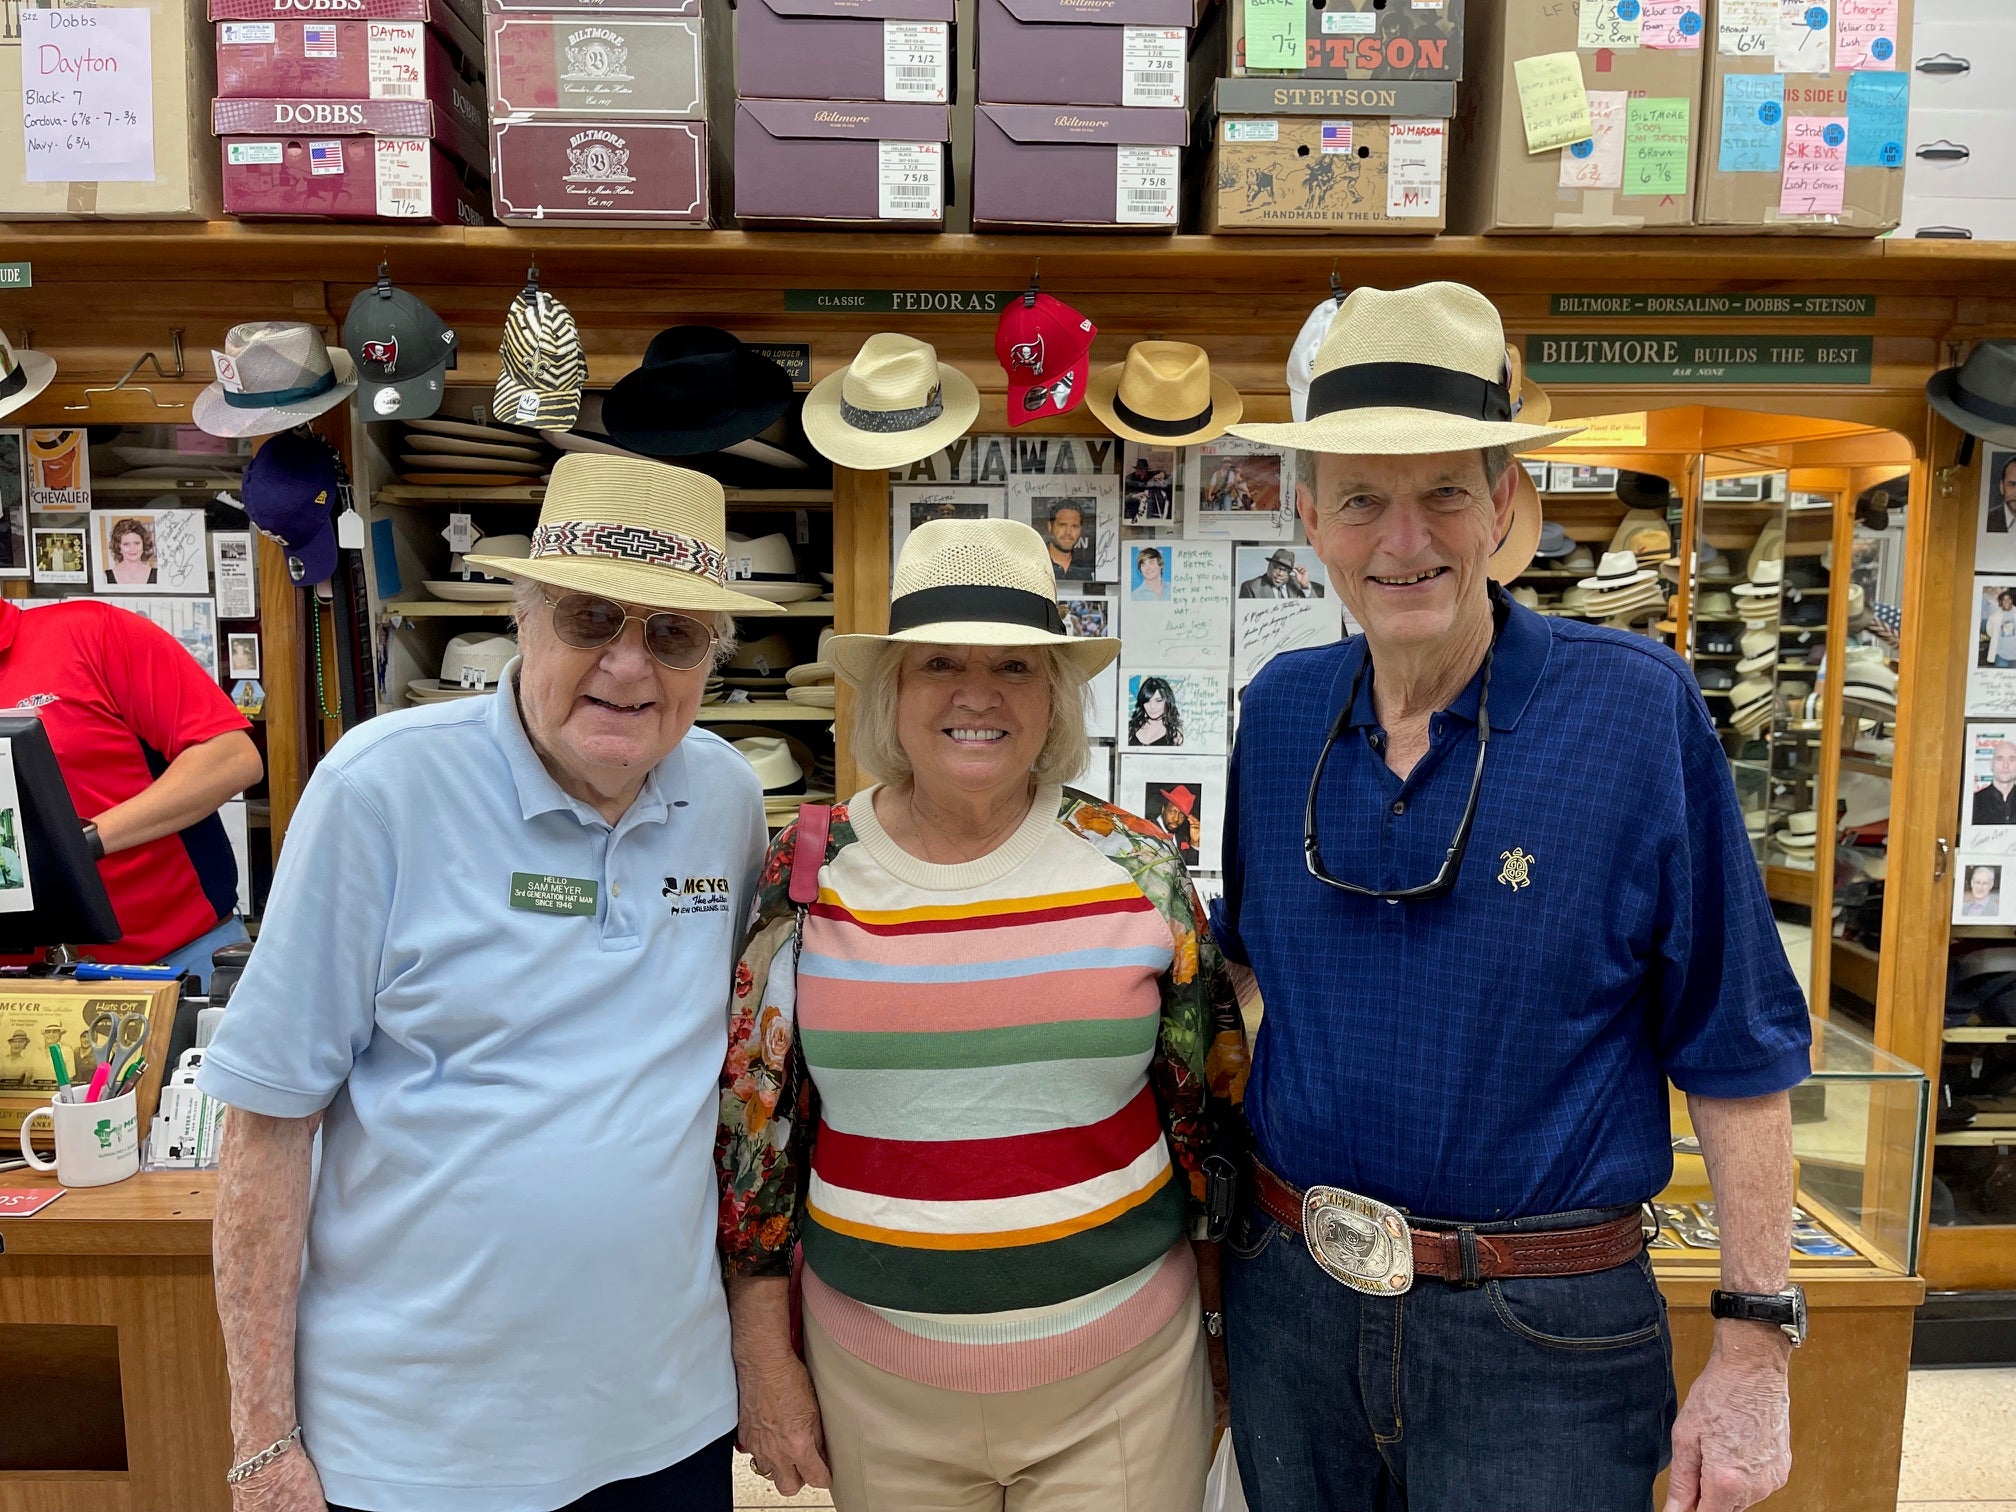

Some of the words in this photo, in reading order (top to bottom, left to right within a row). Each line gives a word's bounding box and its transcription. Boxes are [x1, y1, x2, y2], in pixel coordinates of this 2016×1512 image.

[1842, 1, 1888, 20] Charger
[49, 11, 97, 29] Dobbs
[369, 25, 415, 40] DAYTON
[568, 27, 625, 46] BILTMORE
[1840, 37, 1860, 48] Lush
[393, 46, 417, 57] NAVY
[38, 43, 118, 82] Dayton
[909, 55, 915, 63] 7
[917, 55, 935, 64] 1/2
[1156, 61, 1173, 69] 3/8
[73, 90, 83, 105] 7
[1274, 89, 1397, 107] STETSON
[1804, 89, 1834, 103] SIDE
[274, 104, 363, 125] DOBBS
[813, 110, 871, 124] Biltmore
[1631, 110, 1685, 121] BILTMORE
[1053, 115, 1109, 128] Biltmore
[569, 129, 626, 149] BILTMORE
[377, 139, 425, 153] DAYTON
[1638, 147, 1673, 159] BROWN
[912, 174, 929, 182] 5/8
[1149, 178, 1166, 187] 5/8
[1784, 179, 1807, 190] Lush
[1263, 211, 1328, 220] HANDMADE
[1331, 211, 1344, 219] IN
[1347, 212, 1369, 220] THE
[817, 296, 865, 306] CLASSIC
[892, 293, 996, 310] FEDORAS
[1559, 298, 1631, 312] BILTMORE
[1647, 298, 1729, 312] BORSALINO
[1745, 298, 1791, 312] DOBBS
[1805, 298, 1866, 312] STETSON
[773, 350, 801, 358] LONGER
[1542, 341, 1679, 364] BILTMORE
[1694, 348, 1758, 363] BUILDS
[1770, 348, 1804, 363] THE
[1817, 348, 1858, 363] BEST
[786, 359, 804, 367] RICH
[1672, 368, 1692, 376] BAR
[1697, 368, 1725, 376] NONE
[33, 491, 90, 504] CHEVALIER
[543, 875, 567, 885] HELLO
[684, 878, 730, 894] MEYER
[528, 881, 549, 892] SAM
[550, 884, 582, 896] MEYER
[514, 888, 526, 897] 3rd
[526, 890, 564, 901] GENERATION
[565, 894, 578, 902] HAT
[578, 896, 593, 904] MAN
[535, 898, 554, 908] SINCE
[555, 900, 573, 909] 1946
[0, 1002, 41, 1012] MEYER
[95, 1002, 119, 1011] Hats
[120, 1002, 138, 1011] Off
